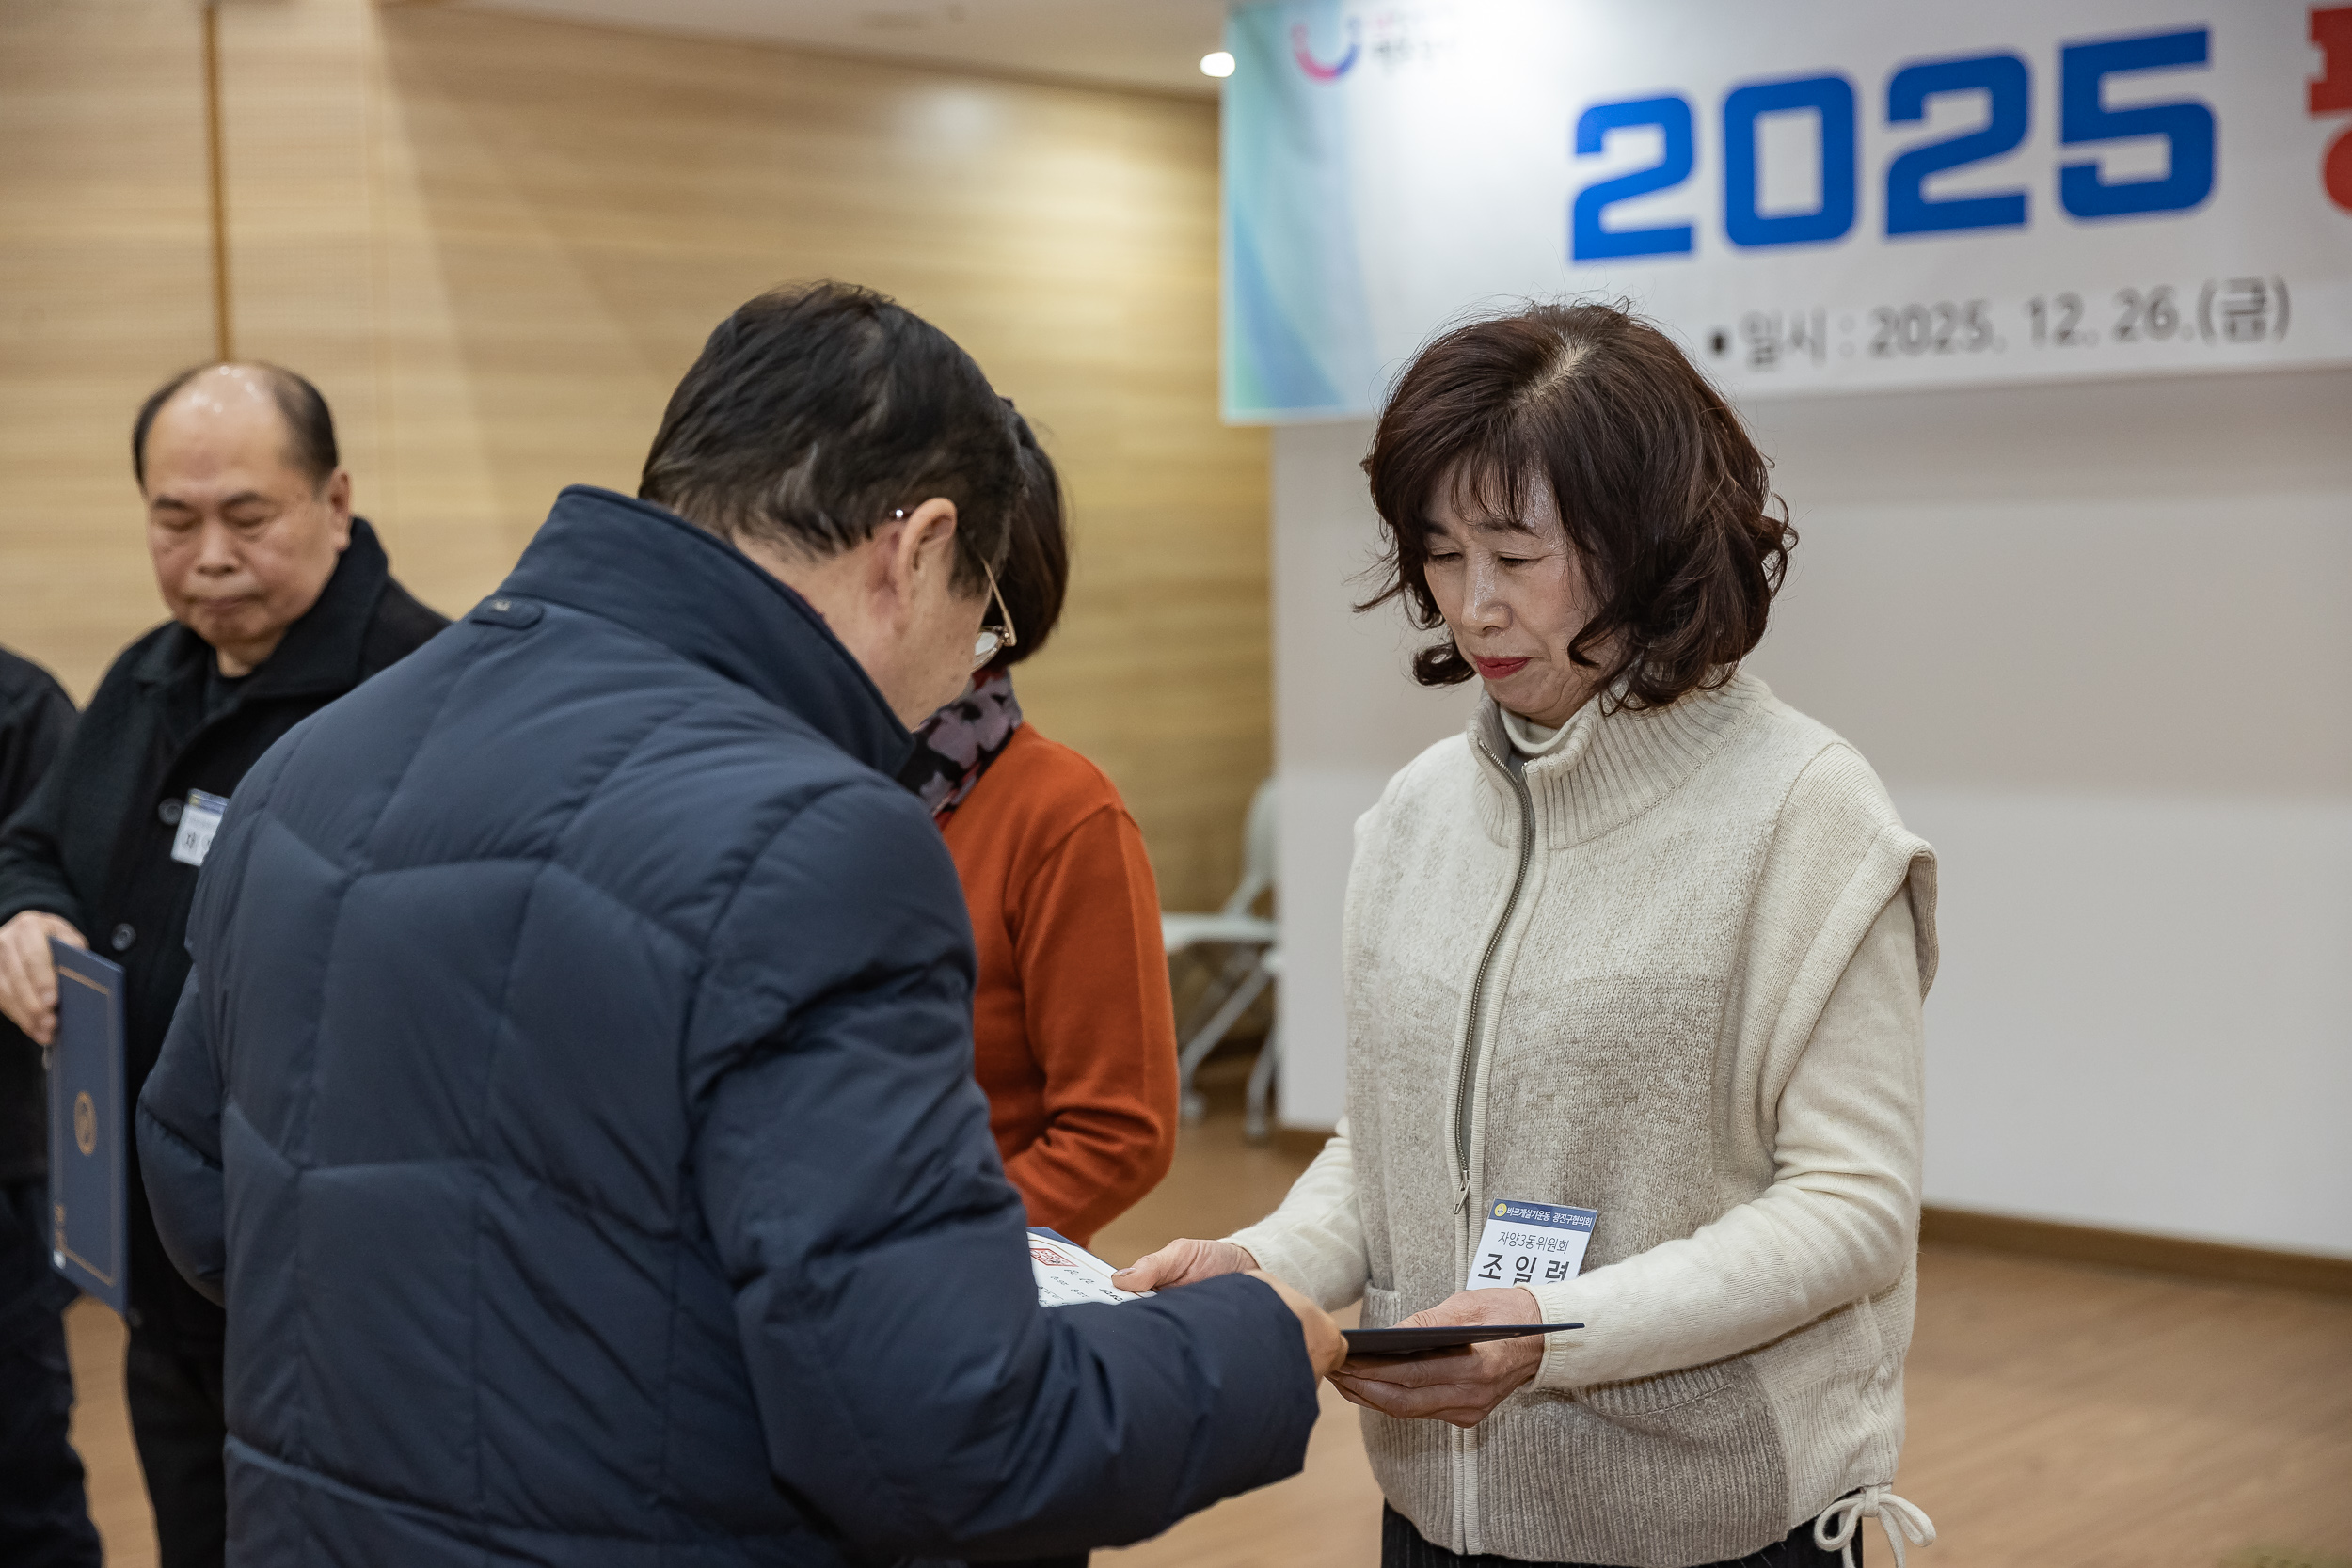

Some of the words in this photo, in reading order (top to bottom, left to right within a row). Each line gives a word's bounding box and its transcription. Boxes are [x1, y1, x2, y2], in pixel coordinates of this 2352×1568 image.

[1570, 24, 2218, 262] 2025
[1740, 303, 1828, 372] 일시
[1867, 297, 2008, 360] 2025.
[2024, 293, 2100, 349] 12.
[1506, 1207, 1551, 1222] 바르게살기운동
[1552, 1212, 1593, 1227] 광진구협의회
[1497, 1231, 1569, 1255] 자양3동위원회
